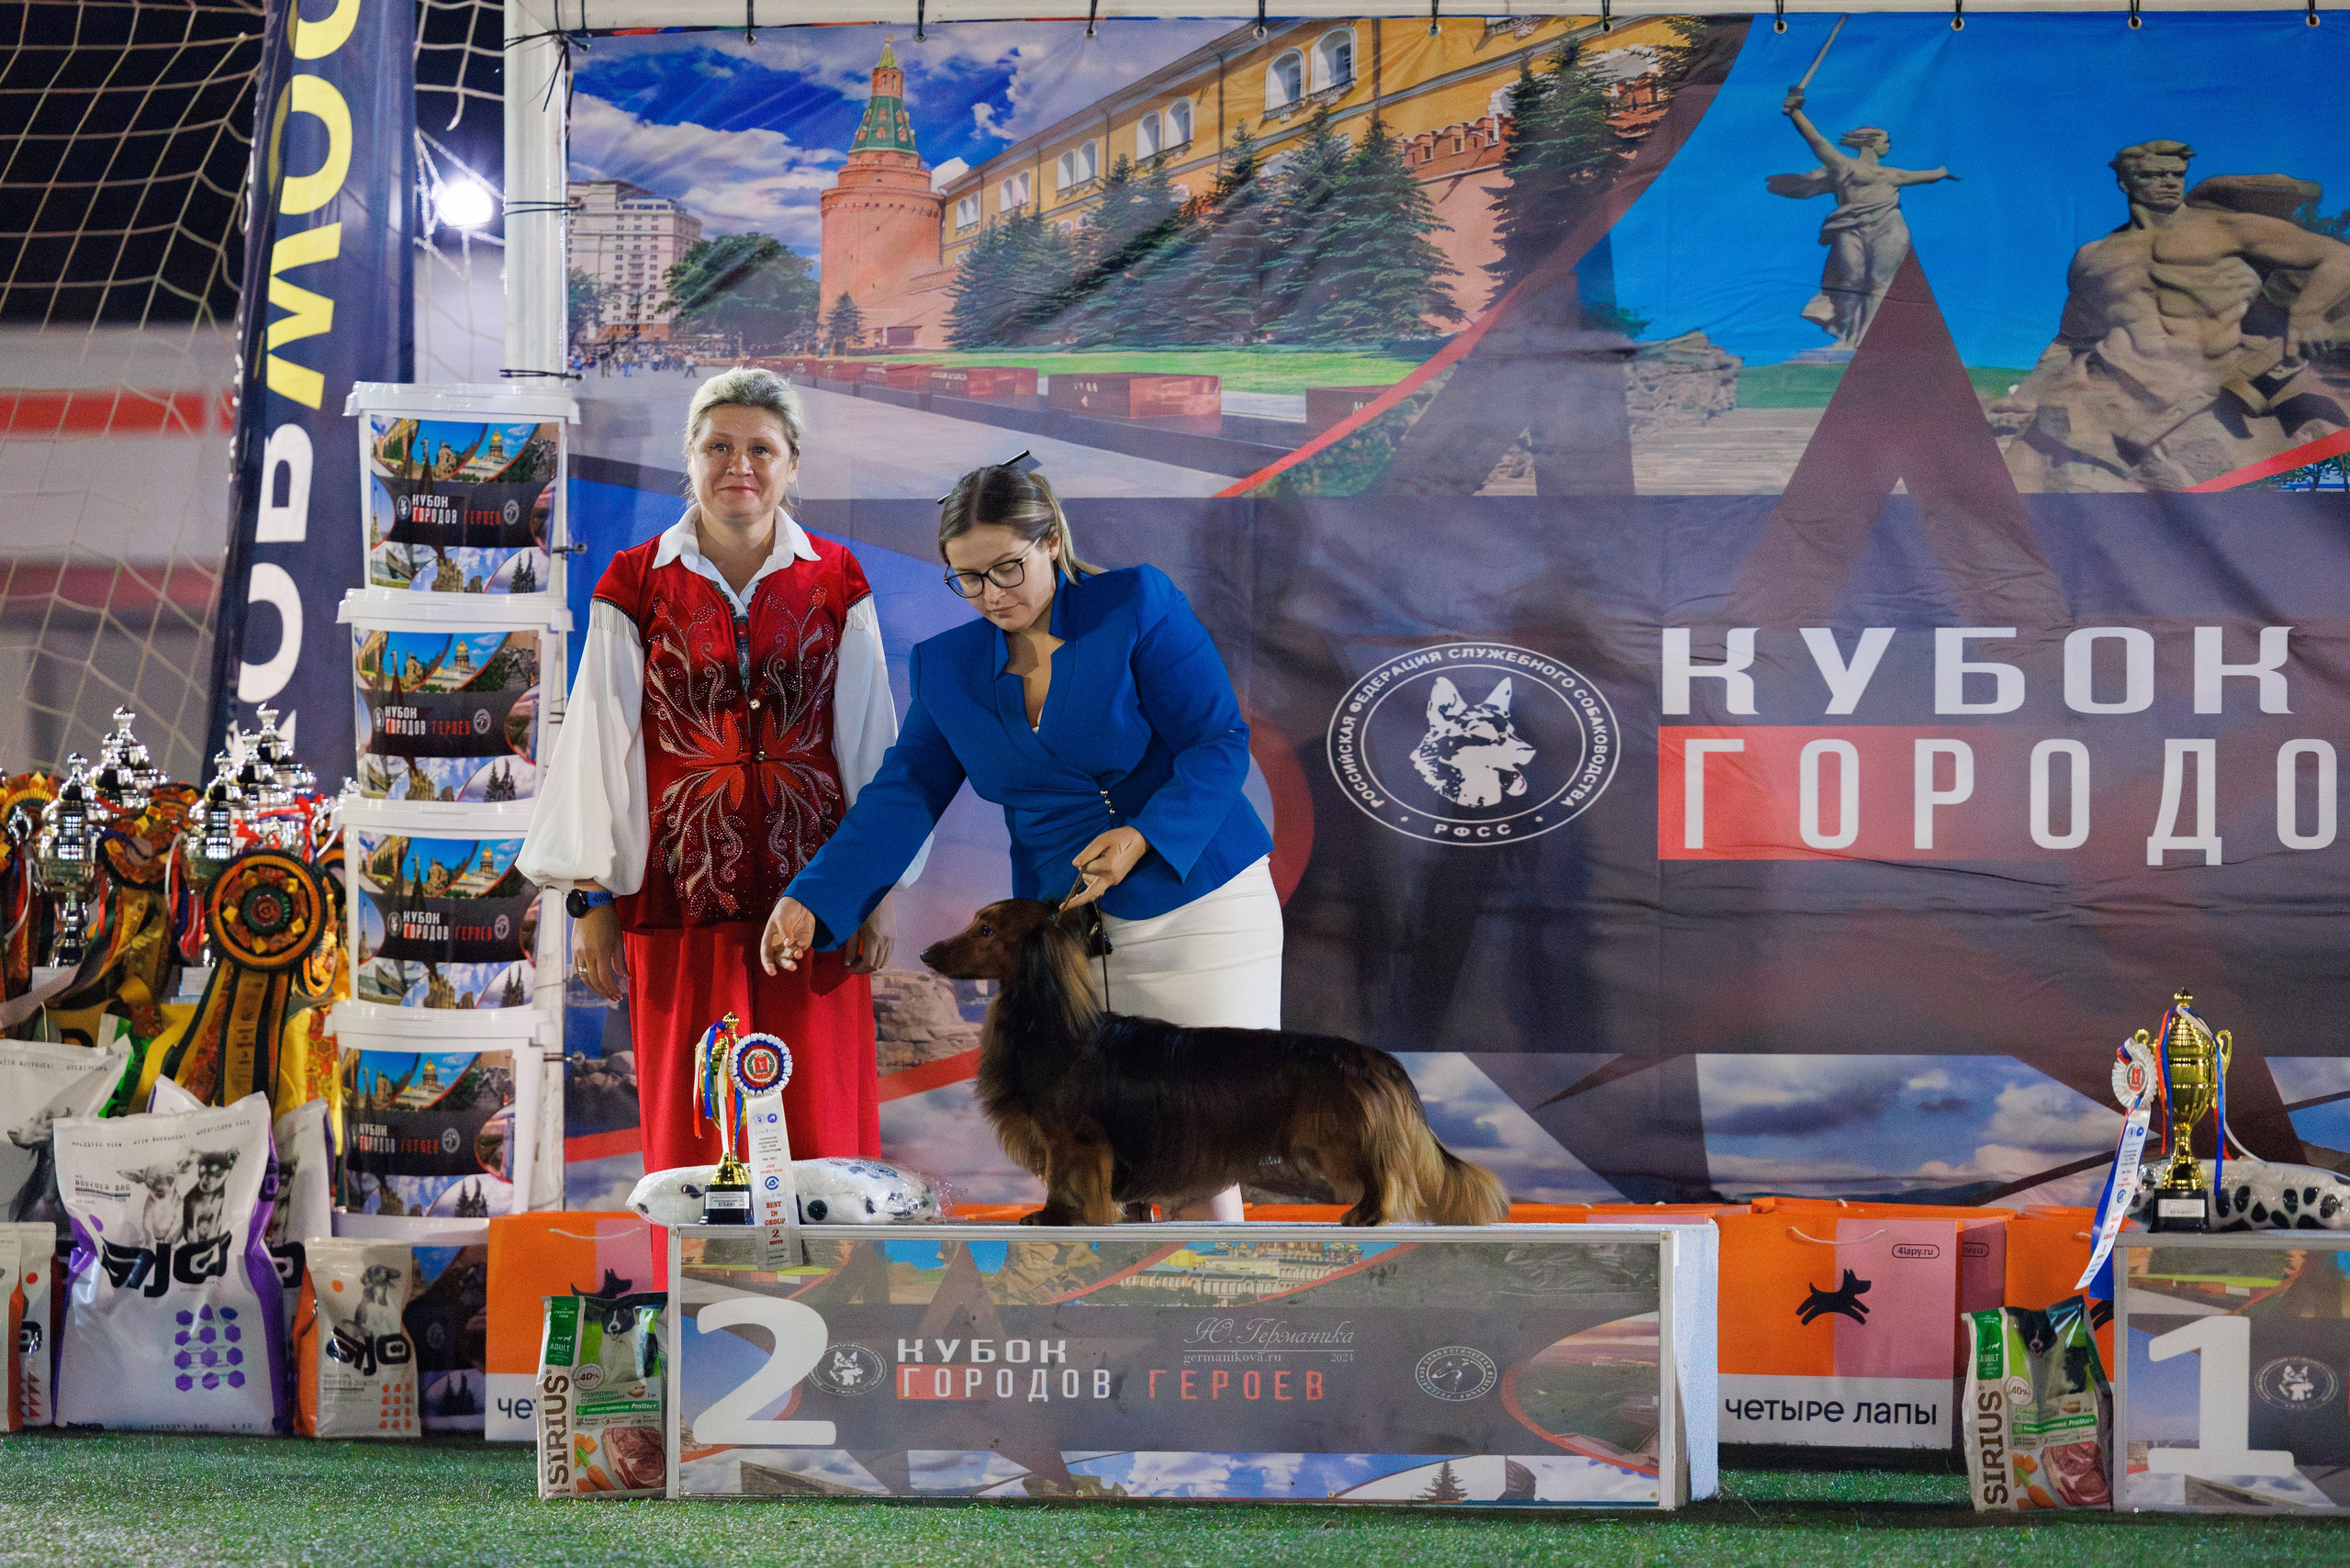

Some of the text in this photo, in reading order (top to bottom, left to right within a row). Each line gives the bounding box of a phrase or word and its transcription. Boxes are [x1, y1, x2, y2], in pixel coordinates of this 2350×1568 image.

[1662, 626, 2296, 715] КУБОК
[1337, 646, 1609, 809] РОССИЙСКАЯ ФЕДЕРАЦИЯ СЛУЖЕБНОГО СОБАКОВОДСТВА
[1684, 738, 2337, 867] ГОРОДО
[1434, 823, 1512, 837] РФСС
[766, 1201, 782, 1209] BEST
[764, 1218, 786, 1226] GROUP
[771, 1228, 780, 1238] 2
[1897, 1247, 1933, 1257] 4lapy.ru
[550, 1342, 570, 1352] ADULT
[898, 1338, 1067, 1364] КУБОК
[579, 1371, 599, 1382] 40%
[692, 1296, 836, 1445] 2
[902, 1368, 1325, 1403] ГОРОДОВ ГЕРОЕВ
[2011, 1385, 2030, 1396] 40%
[2148, 1316, 2294, 1476] 1
[1726, 1400, 1937, 1425] четыре лапы
[543, 1375, 570, 1485] SIRIUS
[1978, 1390, 2009, 1506] SIRIUS
